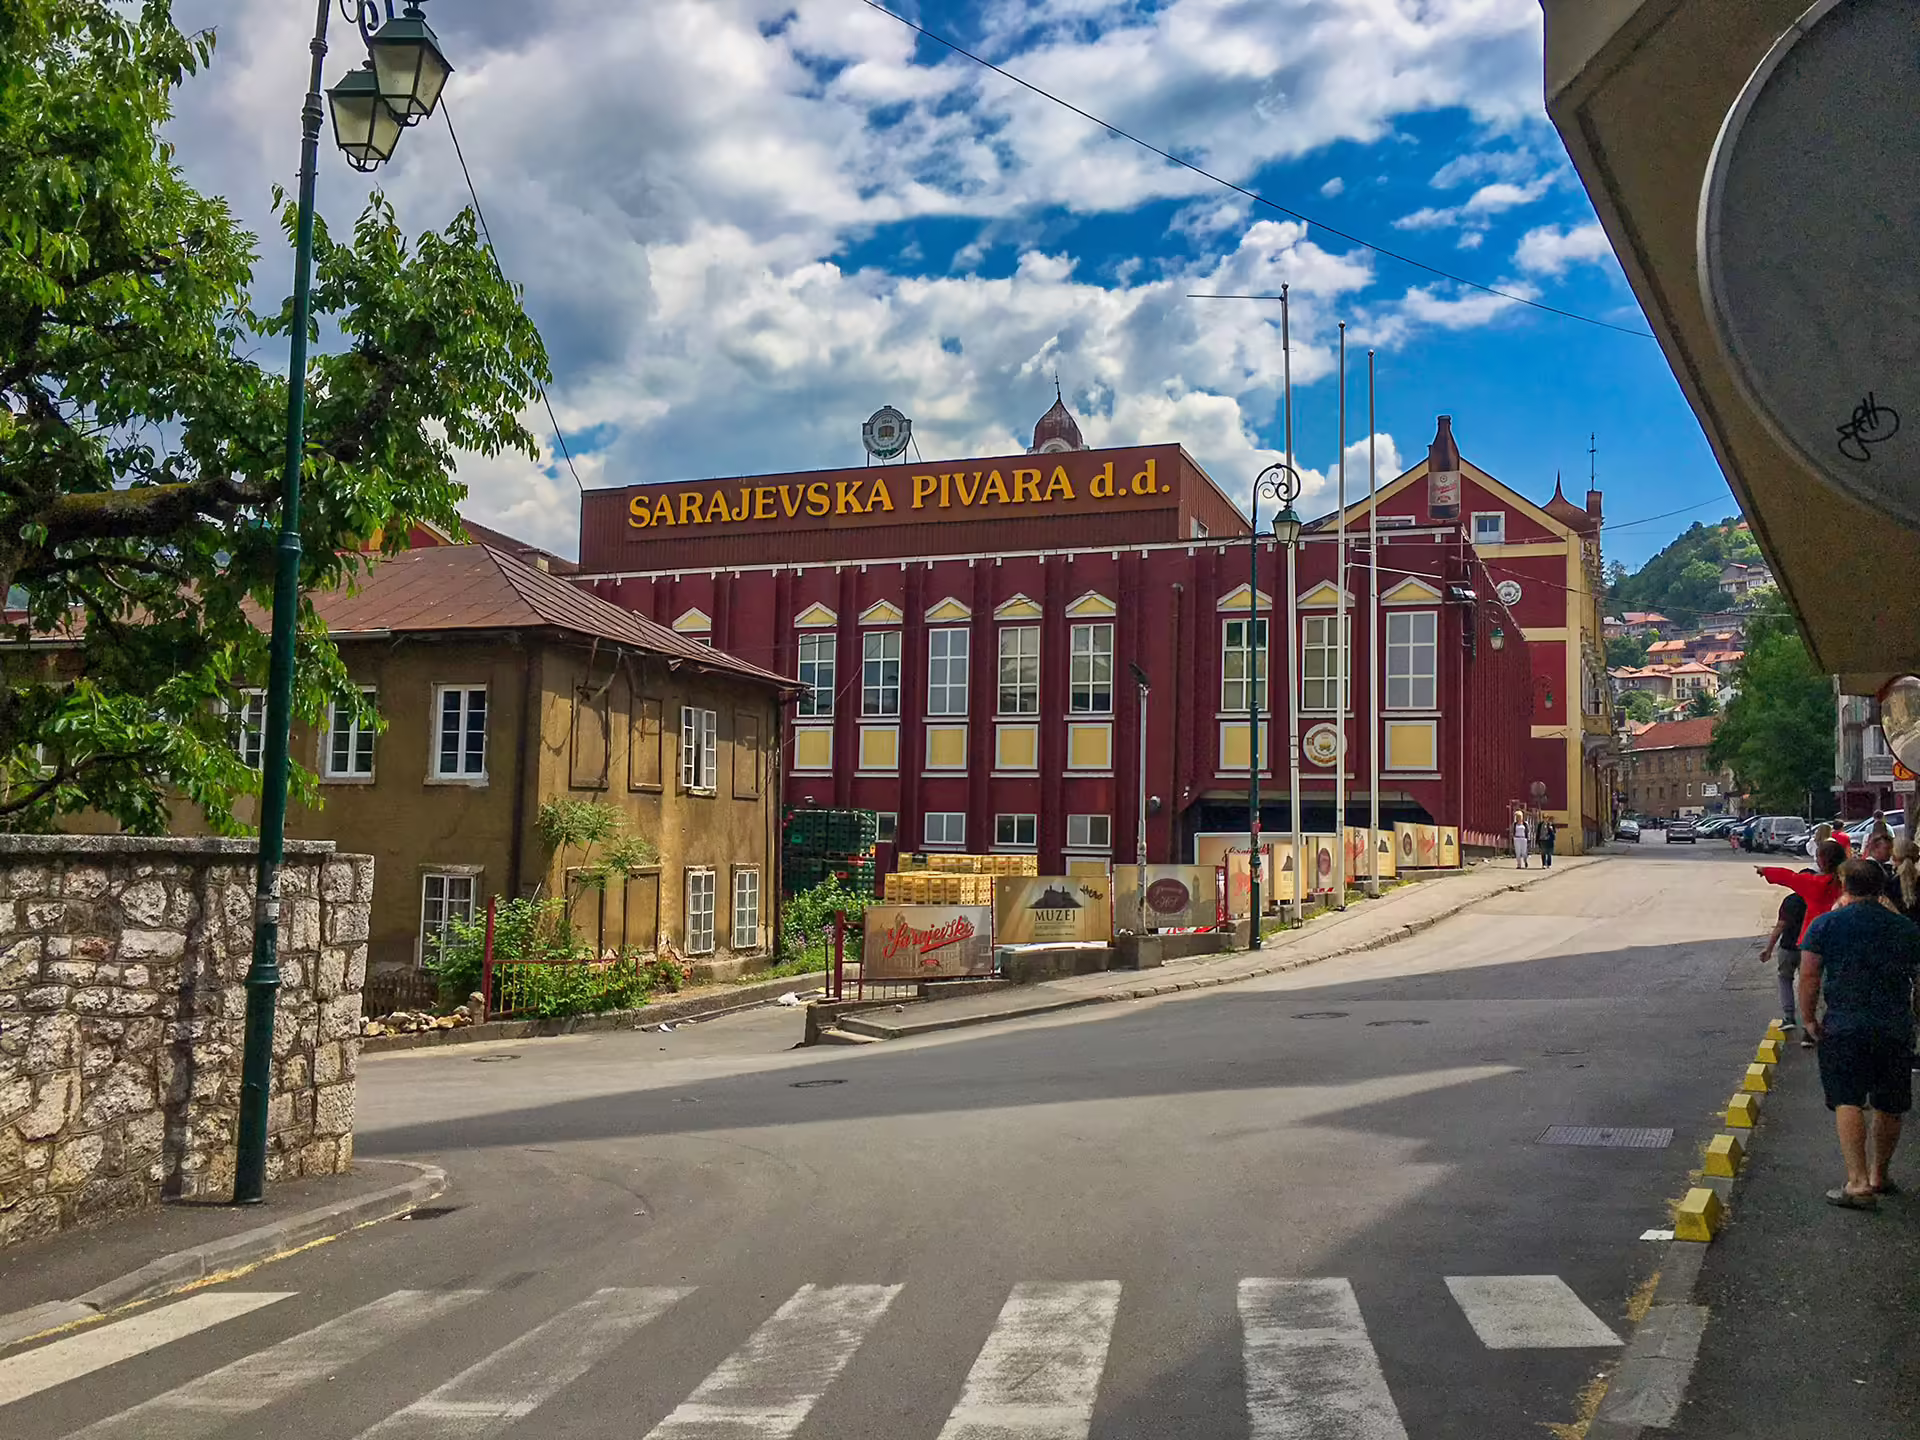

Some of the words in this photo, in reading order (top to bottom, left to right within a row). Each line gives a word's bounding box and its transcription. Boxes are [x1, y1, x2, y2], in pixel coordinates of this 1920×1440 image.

[628, 478, 894, 529] SARAJEVSKA
[911, 465, 1076, 509] PIVARA
[1089, 459, 1171, 498] d.d.
[1034, 909, 1076, 923] MUZEJ
